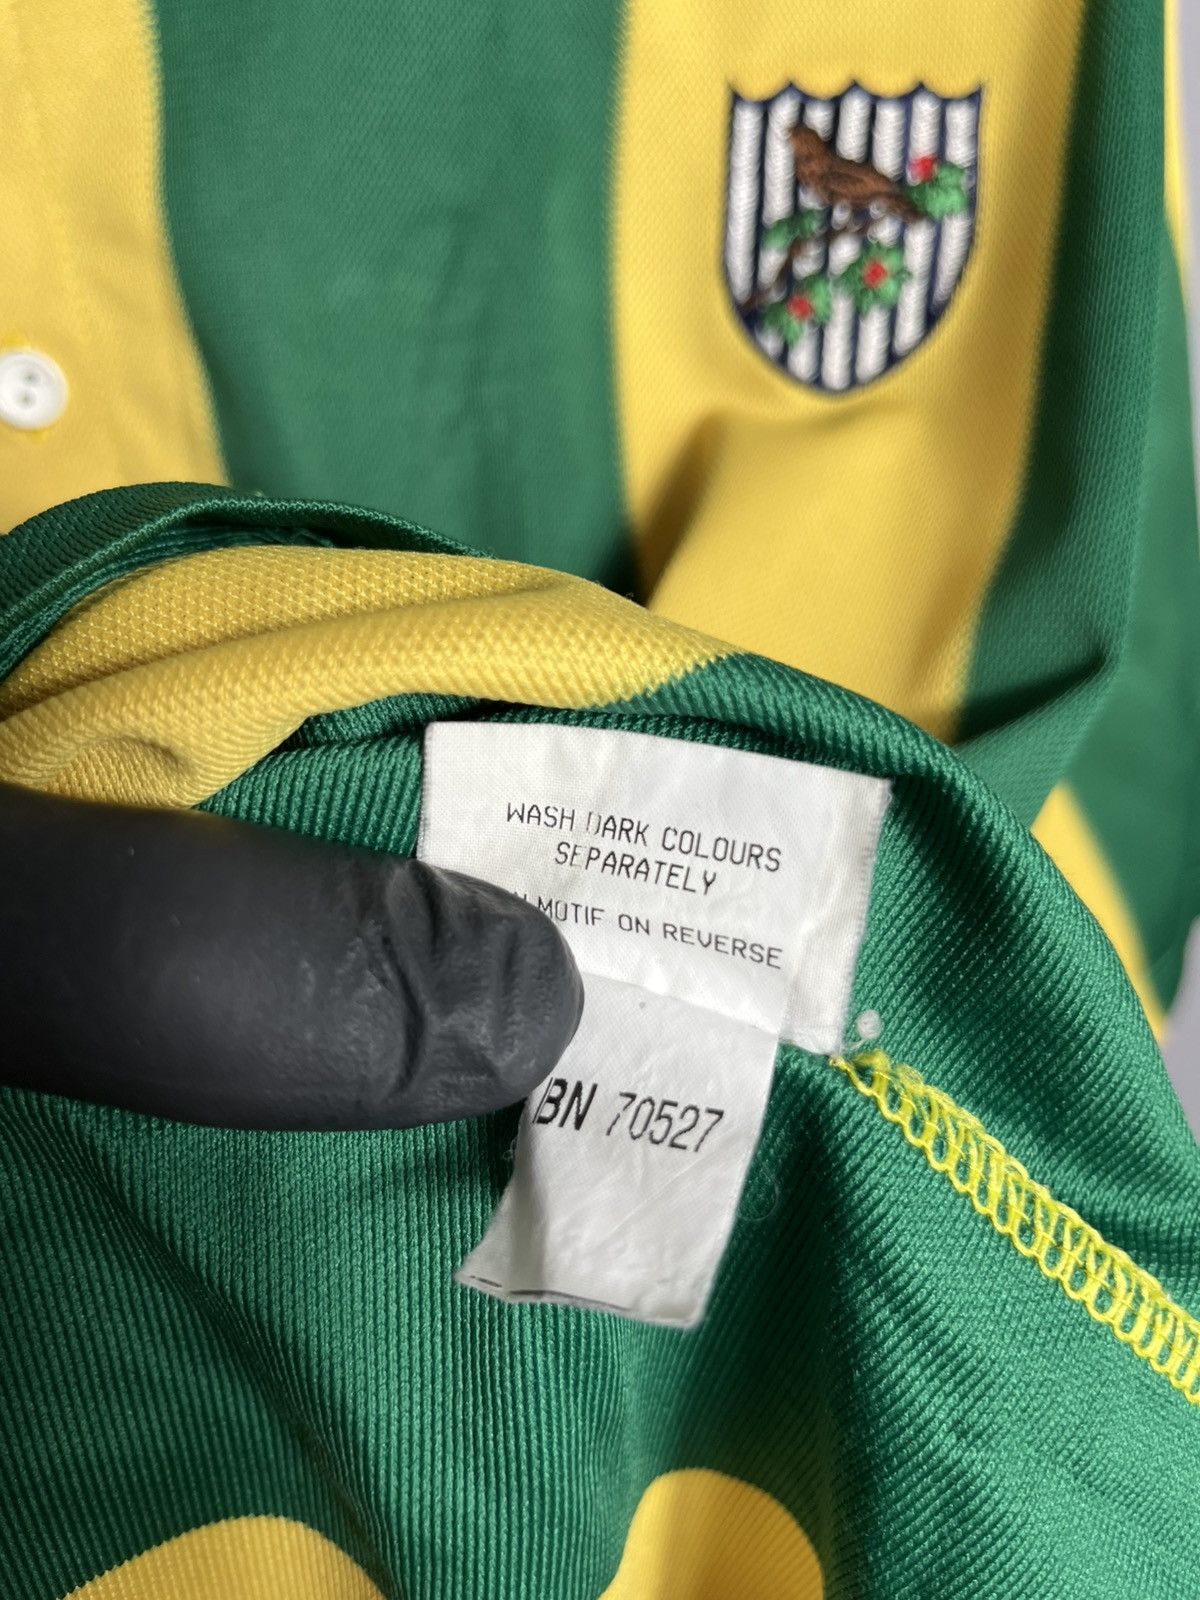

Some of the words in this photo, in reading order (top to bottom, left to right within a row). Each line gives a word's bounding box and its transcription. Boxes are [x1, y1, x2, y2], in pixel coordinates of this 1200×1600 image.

[507, 801, 576, 832] WASH
[661, 826, 783, 872] COLOURS
[554, 841, 718, 896] SEPARATELY
[537, 896, 605, 926] MOTIF
[618, 913, 651, 936] ON
[662, 922, 784, 970] REVERSE
[606, 1091, 725, 1152] 70527
